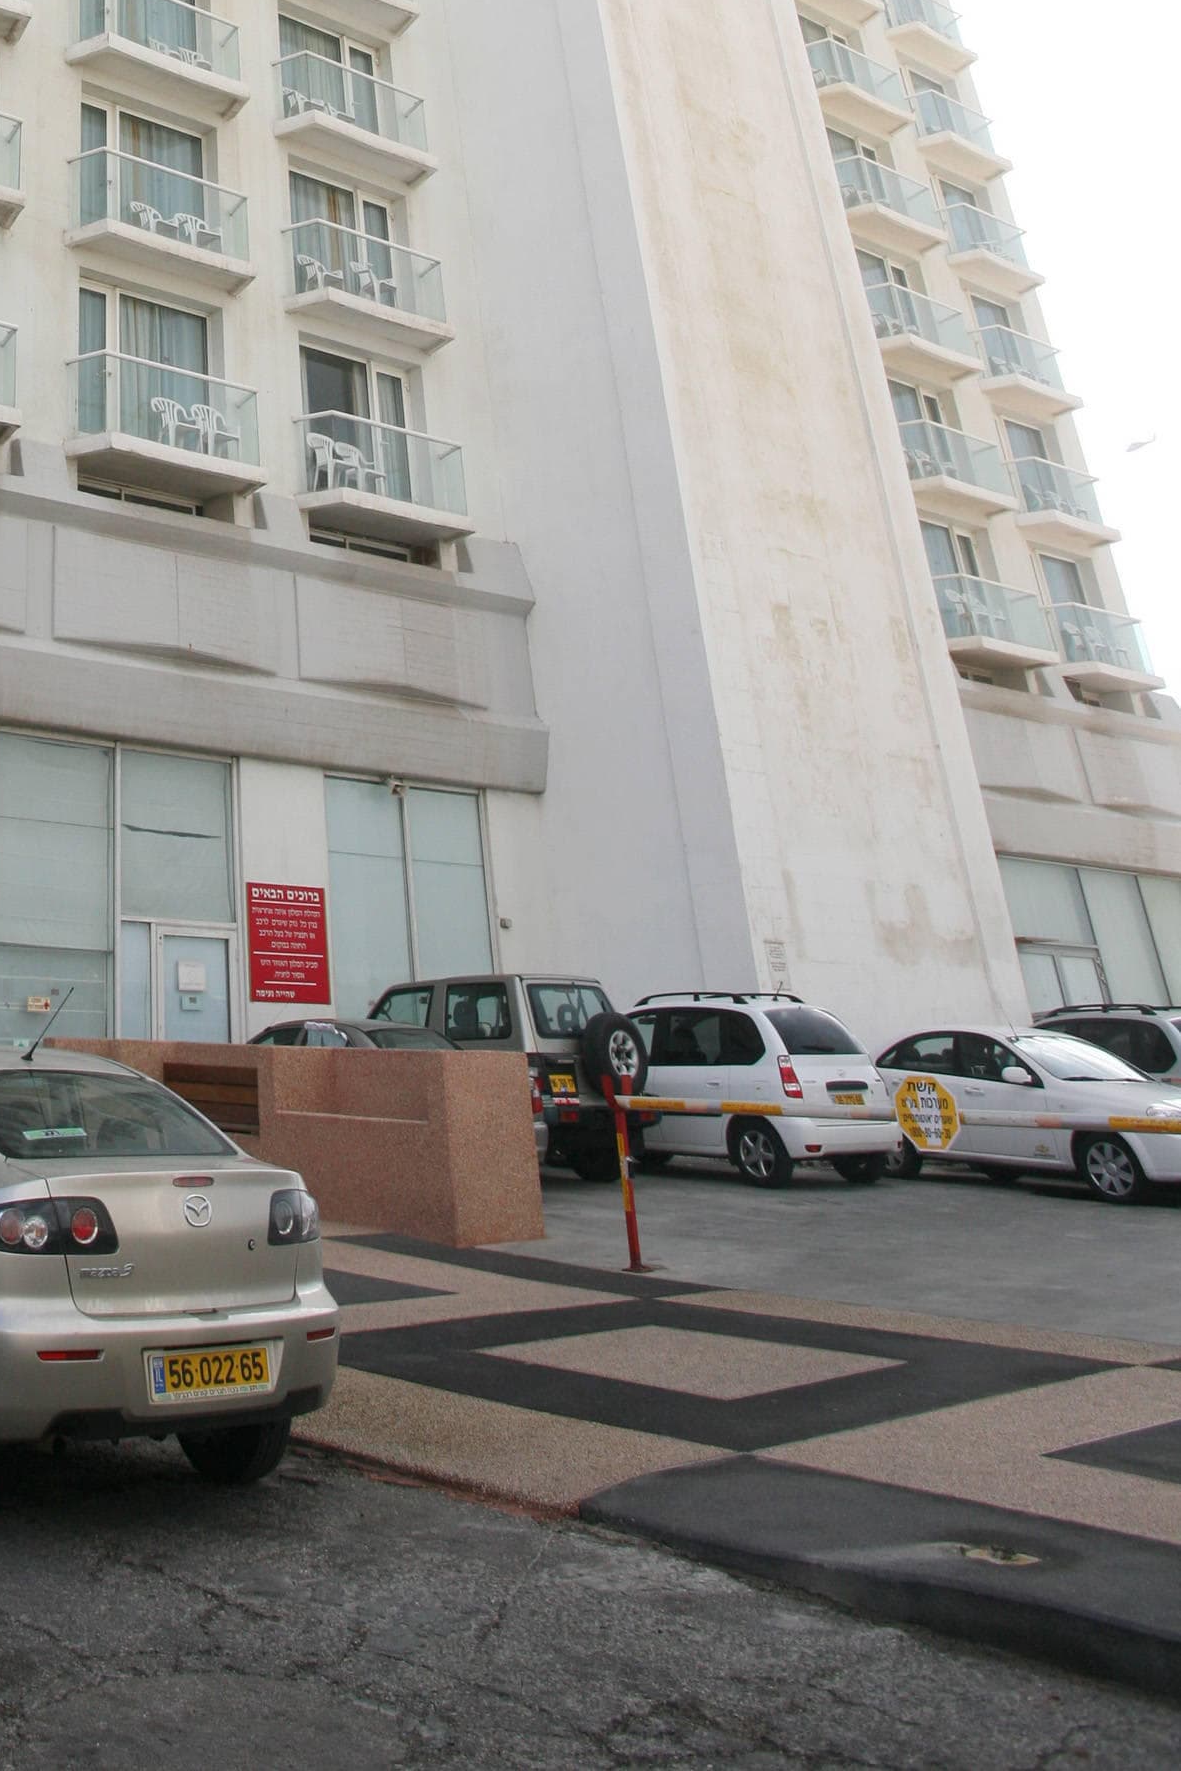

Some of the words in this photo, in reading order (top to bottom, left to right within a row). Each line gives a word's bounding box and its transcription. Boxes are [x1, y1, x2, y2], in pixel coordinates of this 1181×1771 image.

[251, 887, 284, 899] הבאים
[286, 889, 319, 902] ברוכים
[907, 1081, 936, 1095] קשת
